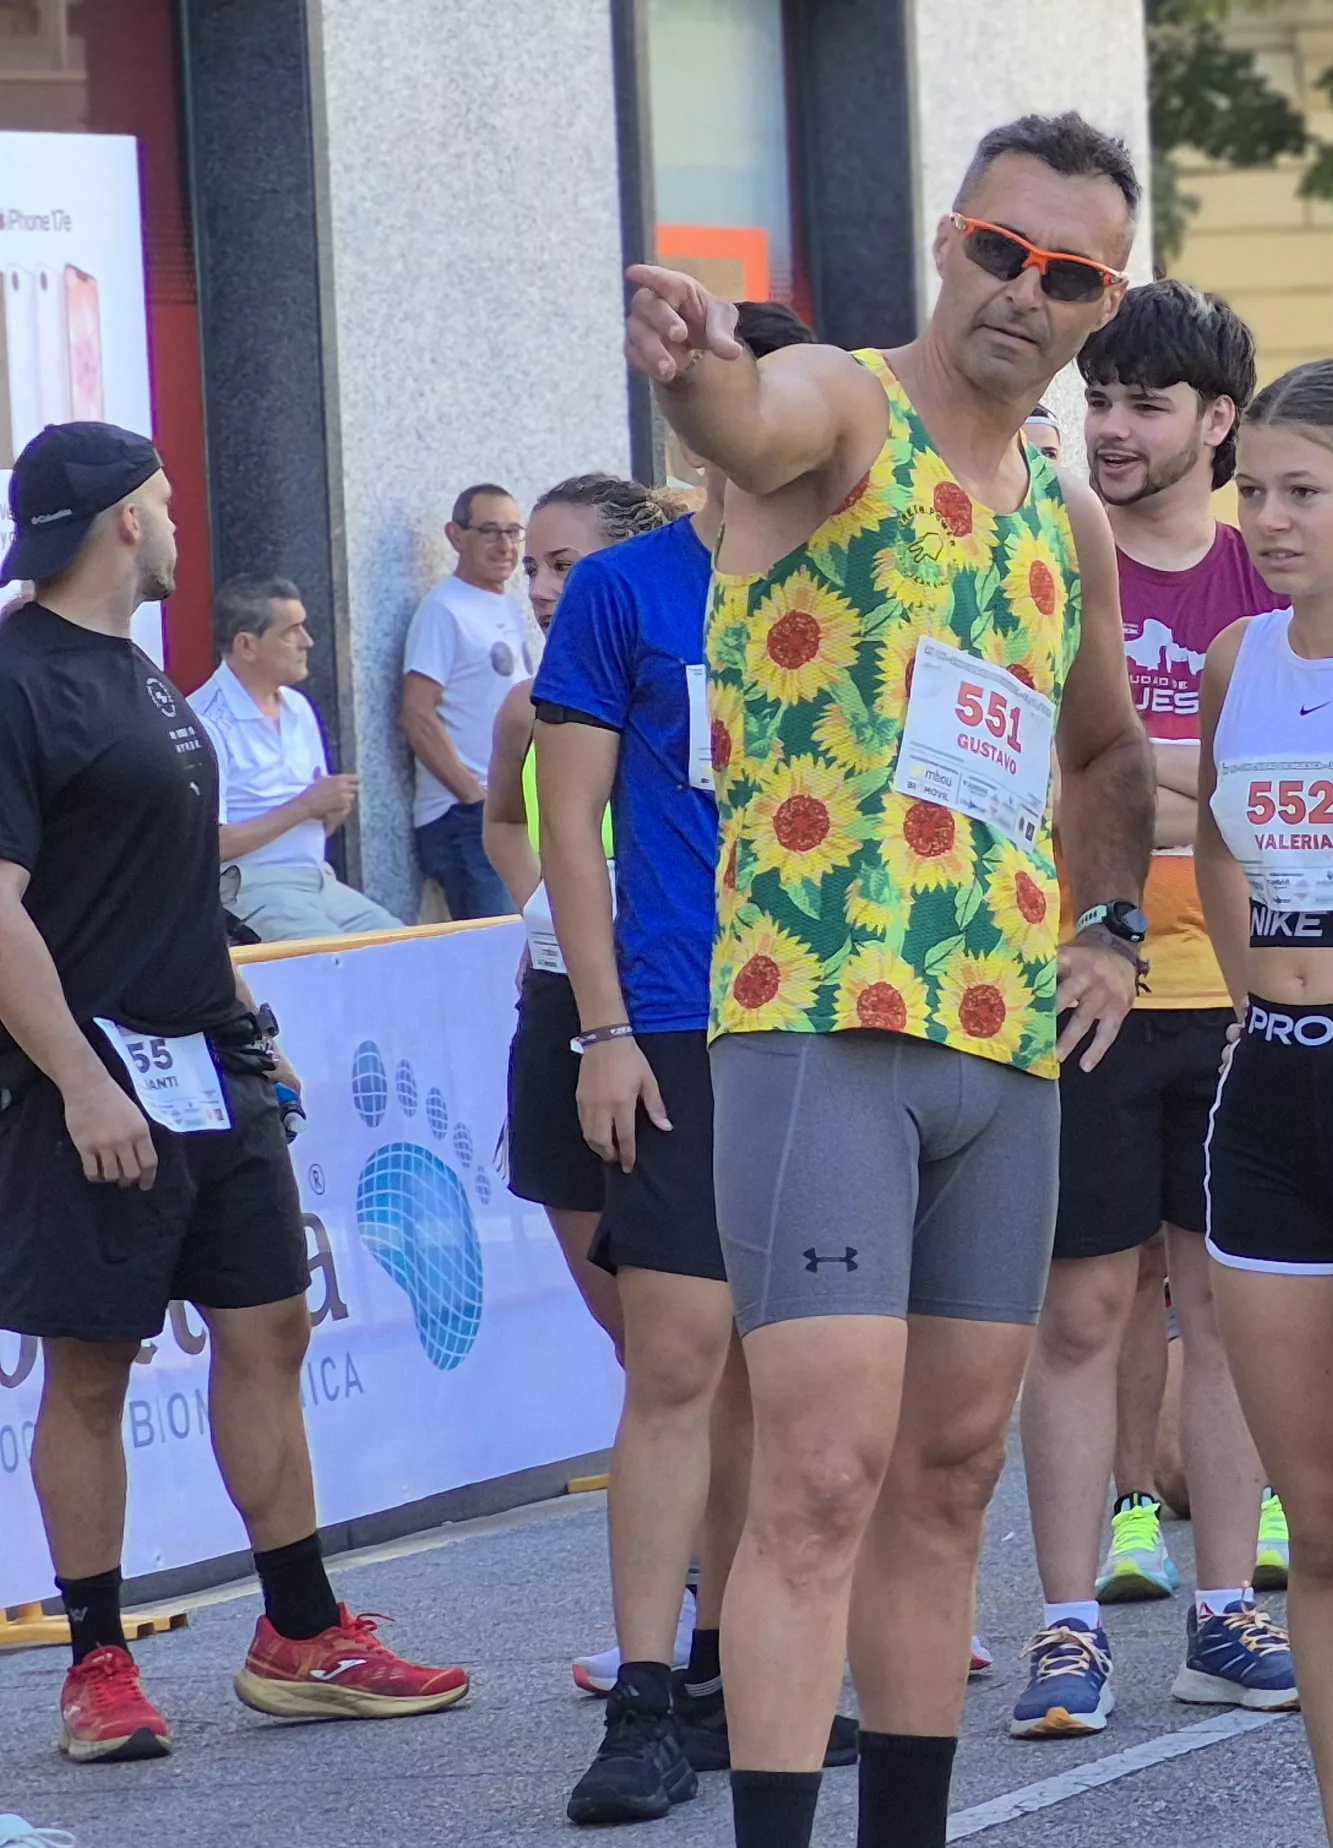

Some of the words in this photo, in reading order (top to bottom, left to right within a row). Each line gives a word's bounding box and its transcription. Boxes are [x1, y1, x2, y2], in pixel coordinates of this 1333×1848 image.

[1129, 674, 1169, 687] UDAD
[954, 680, 1023, 754] 551
[956, 733, 1017, 776] GUSTAVO
[1254, 833, 1333, 850] VALERIA
[1250, 906, 1324, 937] NIKE
